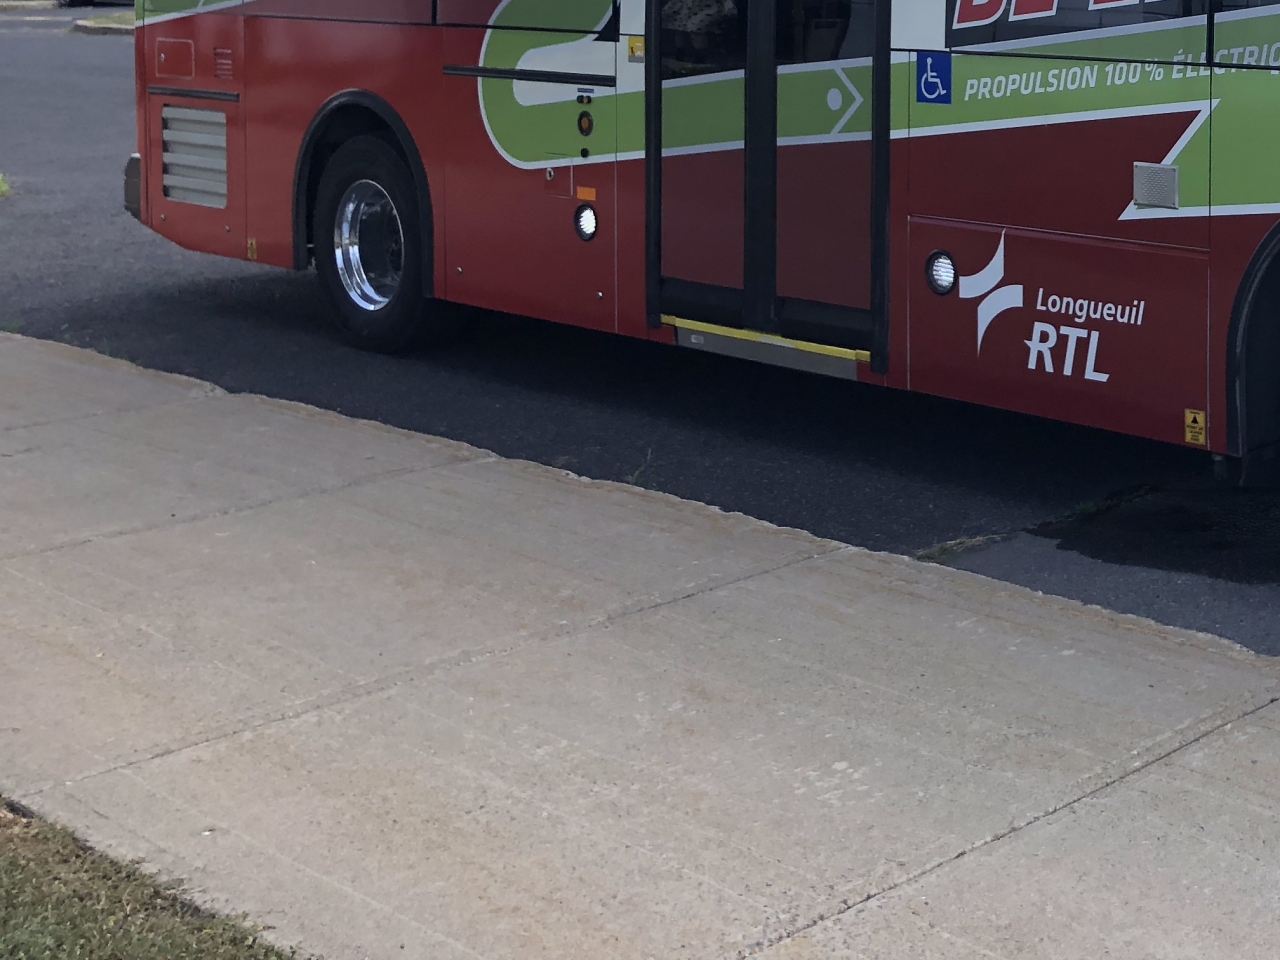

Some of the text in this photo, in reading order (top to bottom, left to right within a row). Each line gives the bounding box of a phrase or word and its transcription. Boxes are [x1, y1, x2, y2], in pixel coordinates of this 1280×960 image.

[965, 65, 1097, 101] PROPULSION
[1105, 59, 1163, 87] 100%
[1036, 287, 1145, 325] Longueuil
[1024, 321, 1110, 382] RTL
